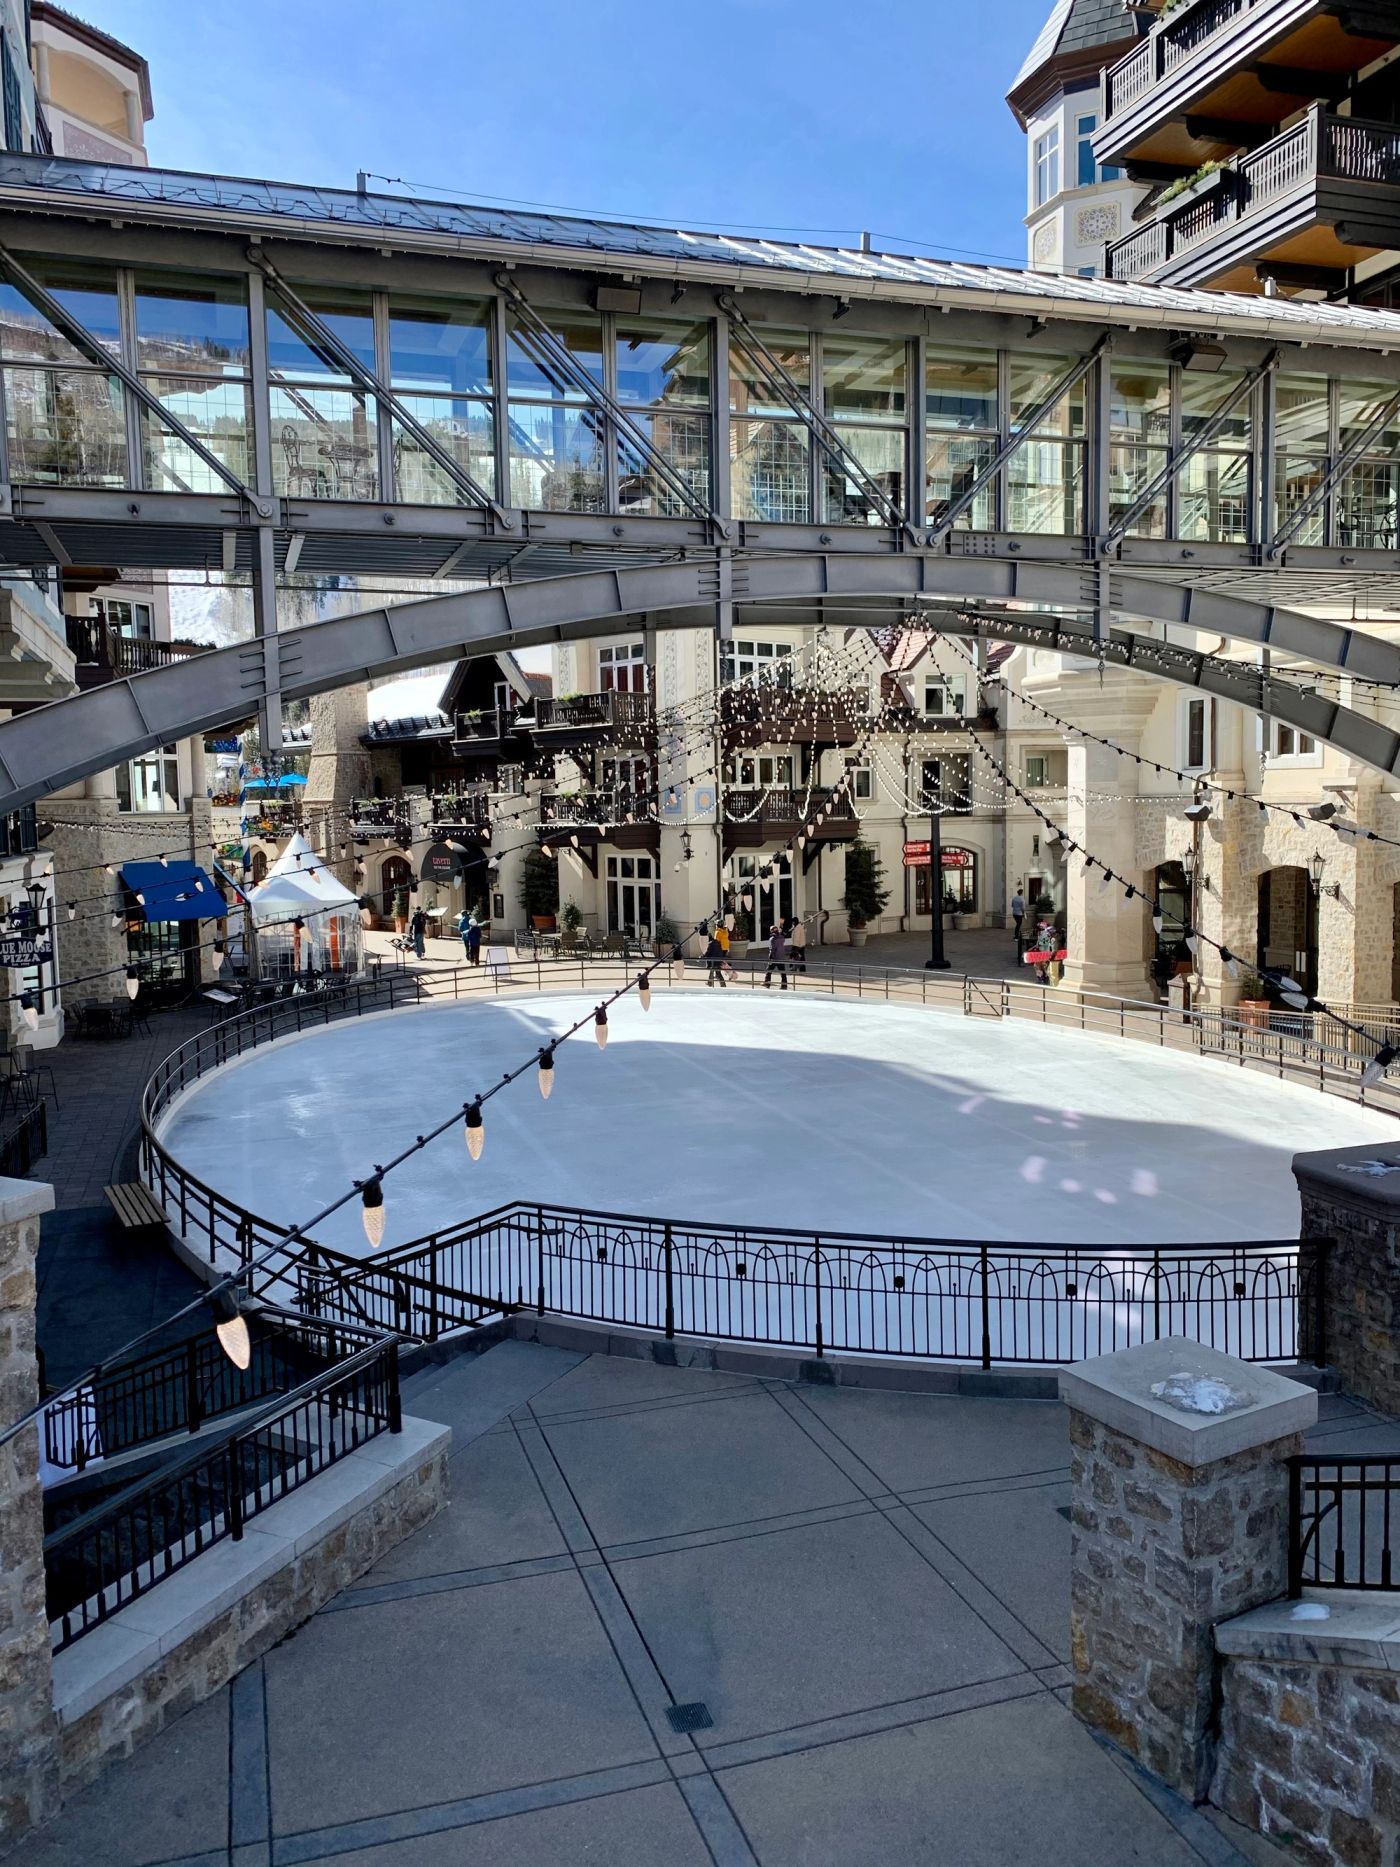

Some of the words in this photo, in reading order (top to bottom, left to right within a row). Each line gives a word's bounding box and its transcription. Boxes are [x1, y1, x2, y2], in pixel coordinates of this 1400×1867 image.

[433, 856, 450, 865] tavern
[17, 941, 52, 954] MOOSE
[2, 953, 41, 963] PIZZA
